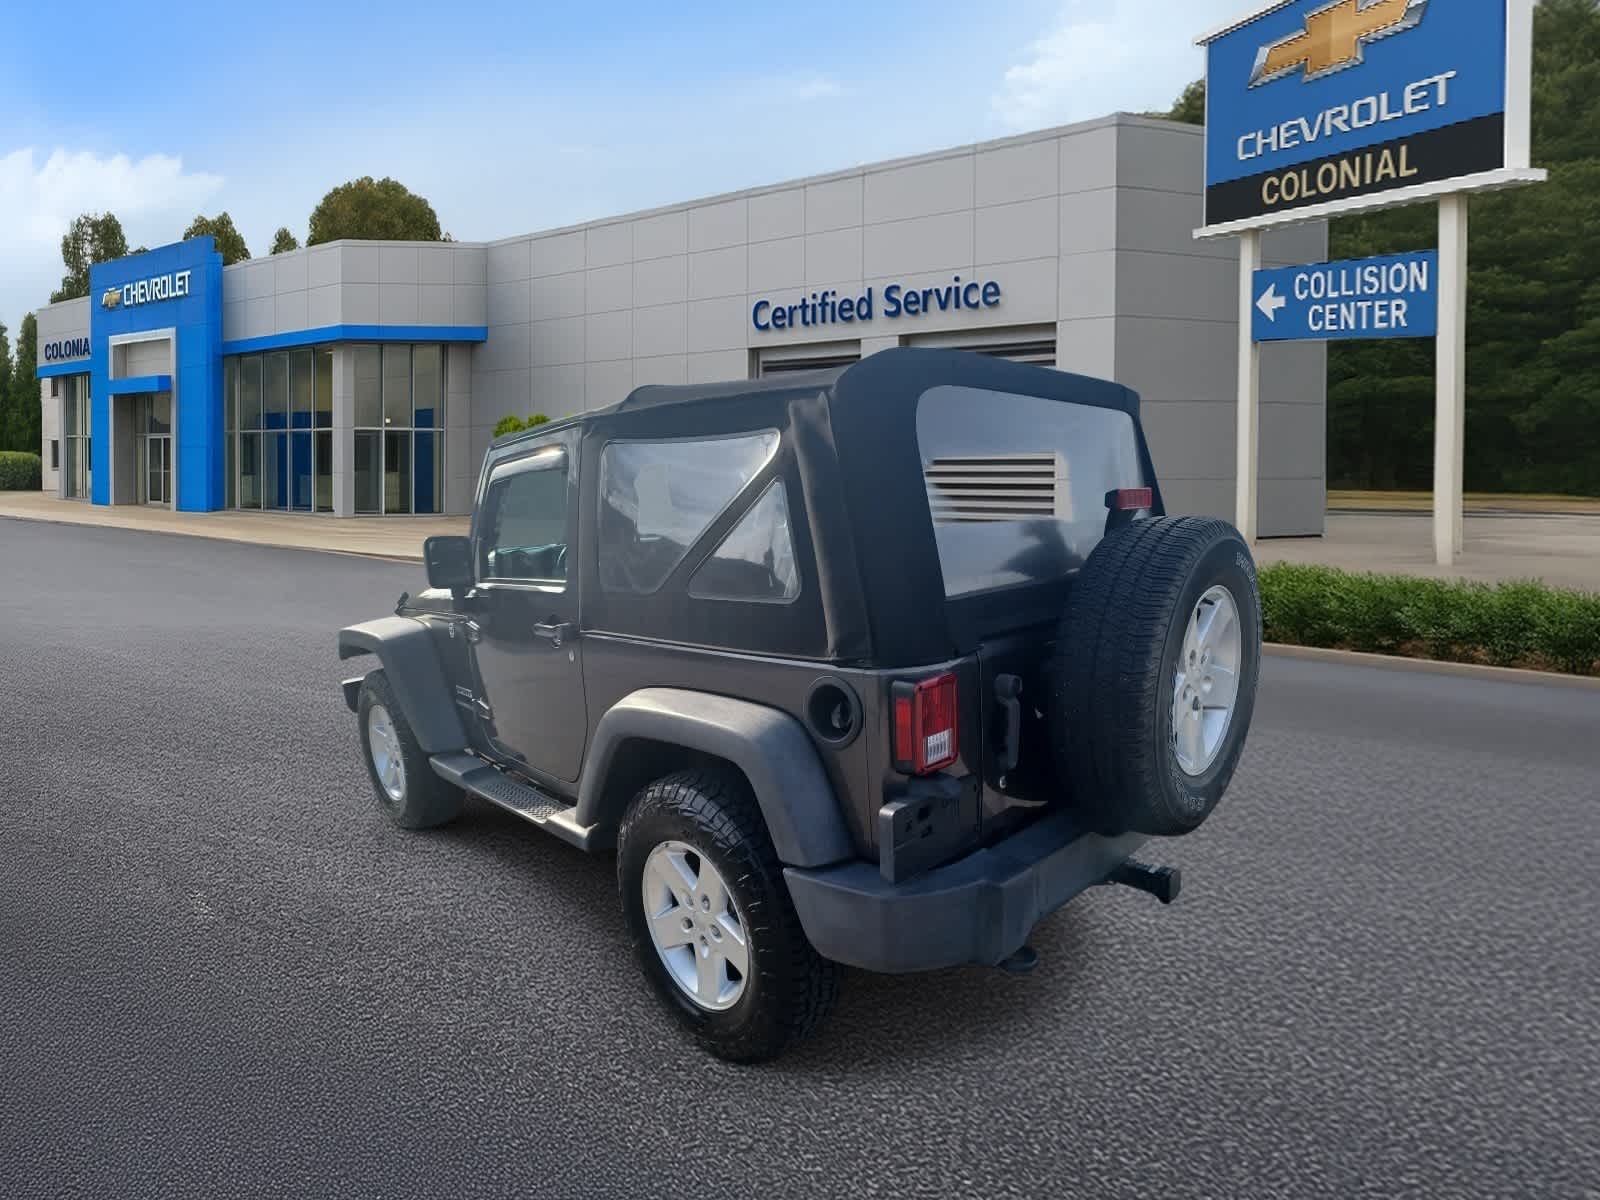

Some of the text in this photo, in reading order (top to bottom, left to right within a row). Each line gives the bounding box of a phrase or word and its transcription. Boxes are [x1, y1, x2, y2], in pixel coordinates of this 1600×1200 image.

[1236, 70, 1456, 160] CHEVROLET
[1261, 144, 1418, 206] COLONIAL
[123, 270, 192, 306] CHEVROLET
[752, 275, 1001, 331] Certified Service
[1294, 260, 1429, 300] COLLISION
[1308, 300, 1408, 332] CENTER
